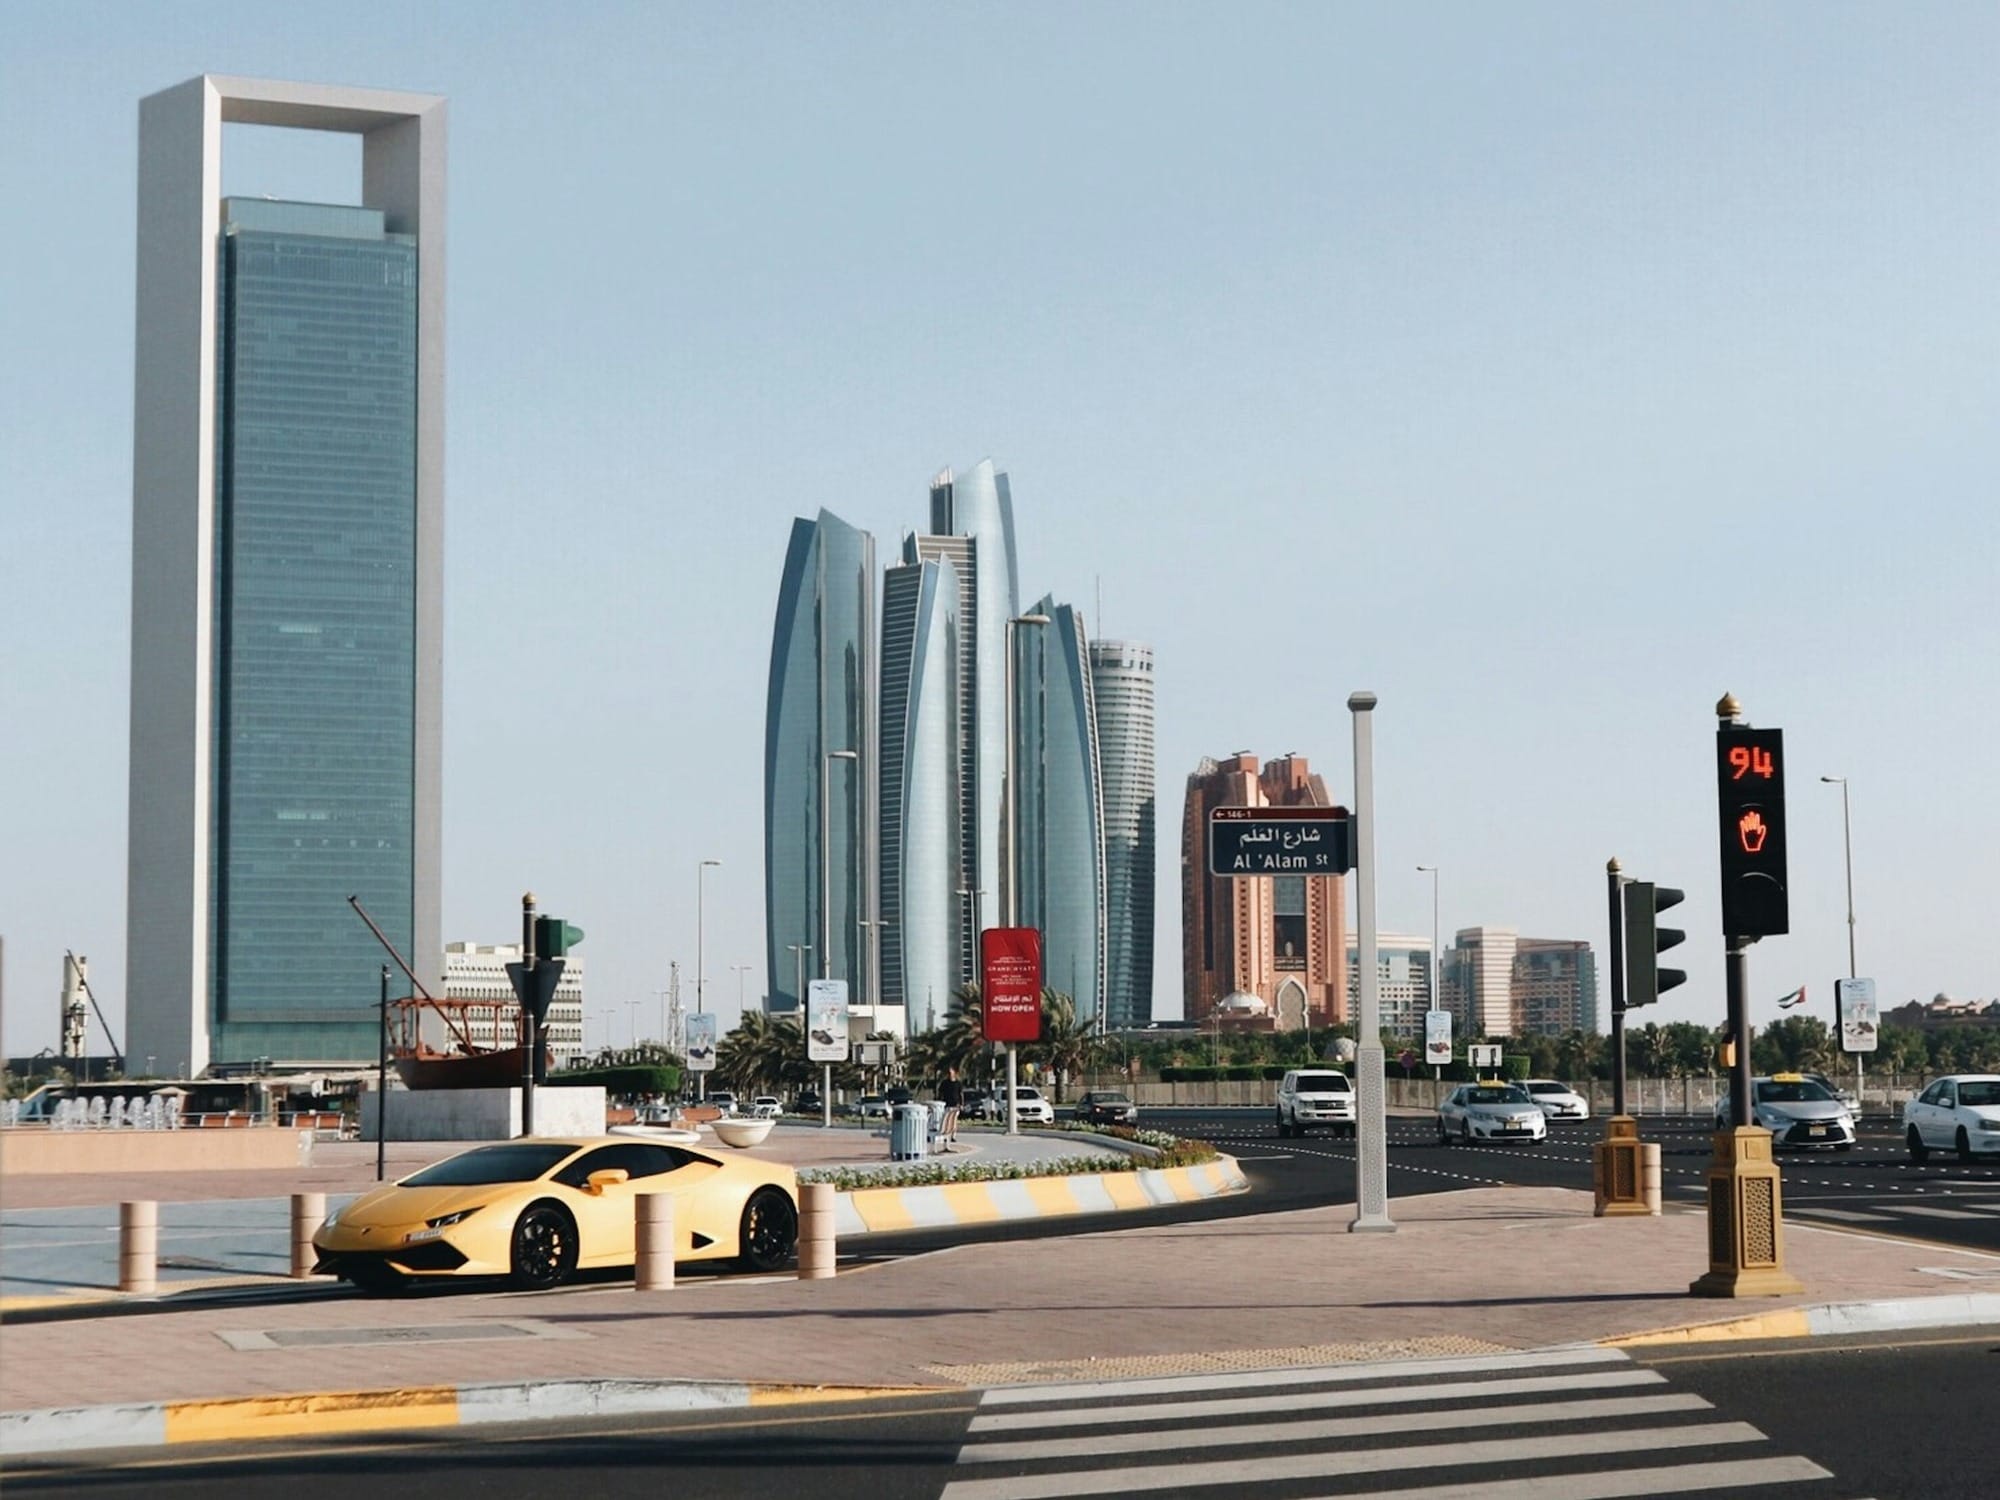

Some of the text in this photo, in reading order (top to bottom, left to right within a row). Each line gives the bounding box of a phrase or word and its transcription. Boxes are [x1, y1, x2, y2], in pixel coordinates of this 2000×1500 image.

[1729, 747, 1774, 780] 94
[1284, 827, 1320, 849] شارع
[1233, 854, 1250, 868] Al
[1315, 854, 1328, 865] St
